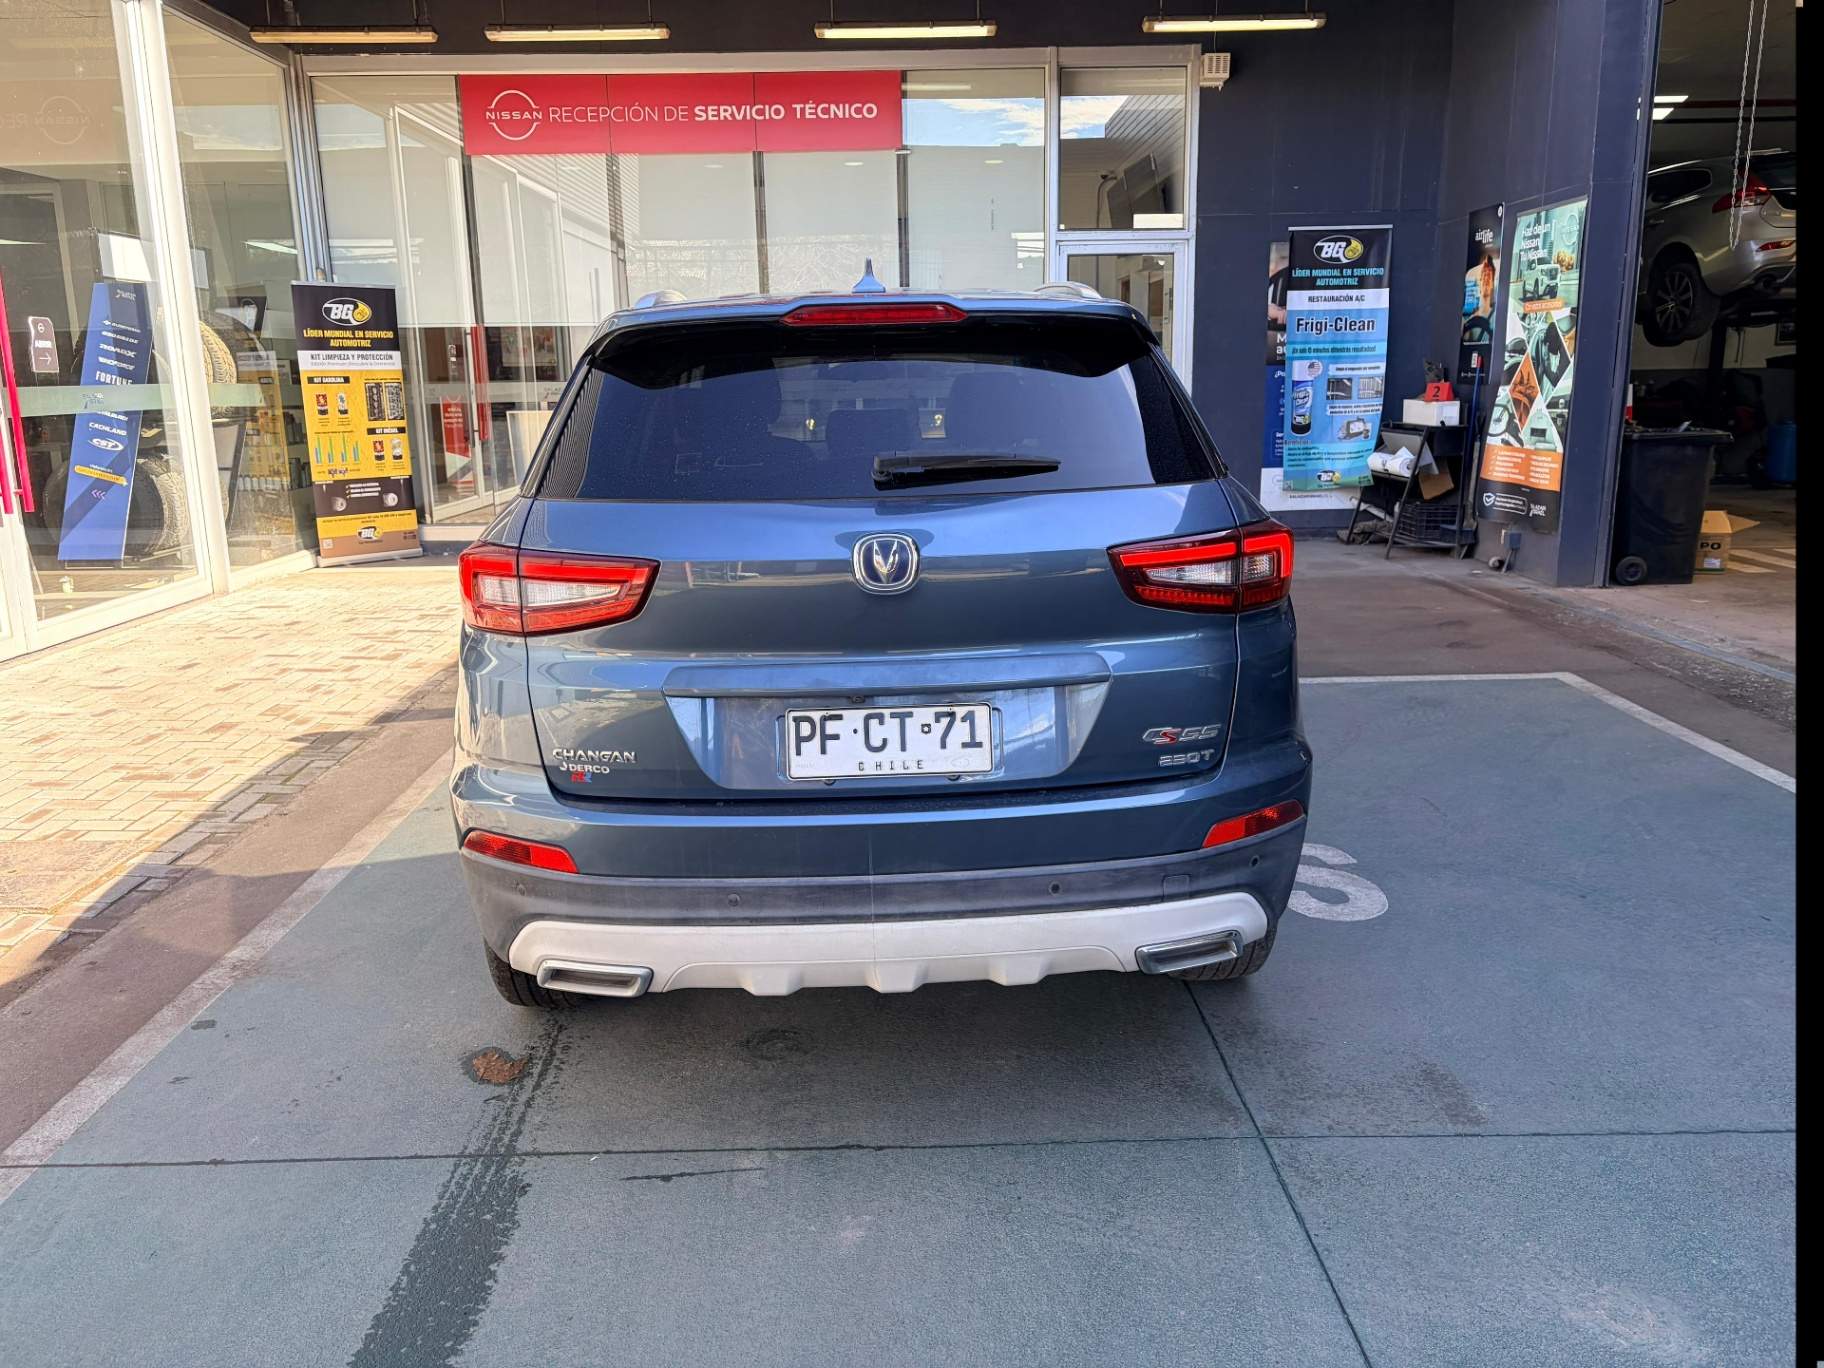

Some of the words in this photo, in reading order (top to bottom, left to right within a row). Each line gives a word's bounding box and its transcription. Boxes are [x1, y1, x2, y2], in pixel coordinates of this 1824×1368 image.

[485, 109, 543, 122] NISSAN
[548, 101, 659, 124] RECEPCIÓN
[663, 106, 690, 122] DE
[693, 104, 786, 122] SERVICIO
[791, 99, 878, 120] TÉCNICO
[1292, 267, 1310, 277] LÍDER
[1312, 268, 1341, 277] MUNDIAL
[1343, 268, 1352, 276] EN
[1353, 267, 1384, 276] SERVICIO
[1316, 277, 1358, 286] AUTOMOTRIZ
[1308, 294, 1353, 303] RESTAURACIÓN
[1295, 315, 1376, 336] Frigi-Clean
[303, 327, 324, 338] LÍDER
[324, 329, 354, 338] MUNDIAL
[355, 329, 364, 338] EN
[364, 330, 394, 339] SERVICIO
[330, 339, 372, 348] AUTOMOTRIZ
[310, 353, 321, 361] KIT
[322, 353, 351, 361] LIMPIEZA
[351, 353, 356, 361] Y
[356, 351, 393, 361] PROTECCIÓN
[1432, 385, 1441, 398] 2
[552, 748, 637, 763] CHANGAN
[568, 763, 610, 774] DERCO
[858, 759, 925, 772] CHILE
